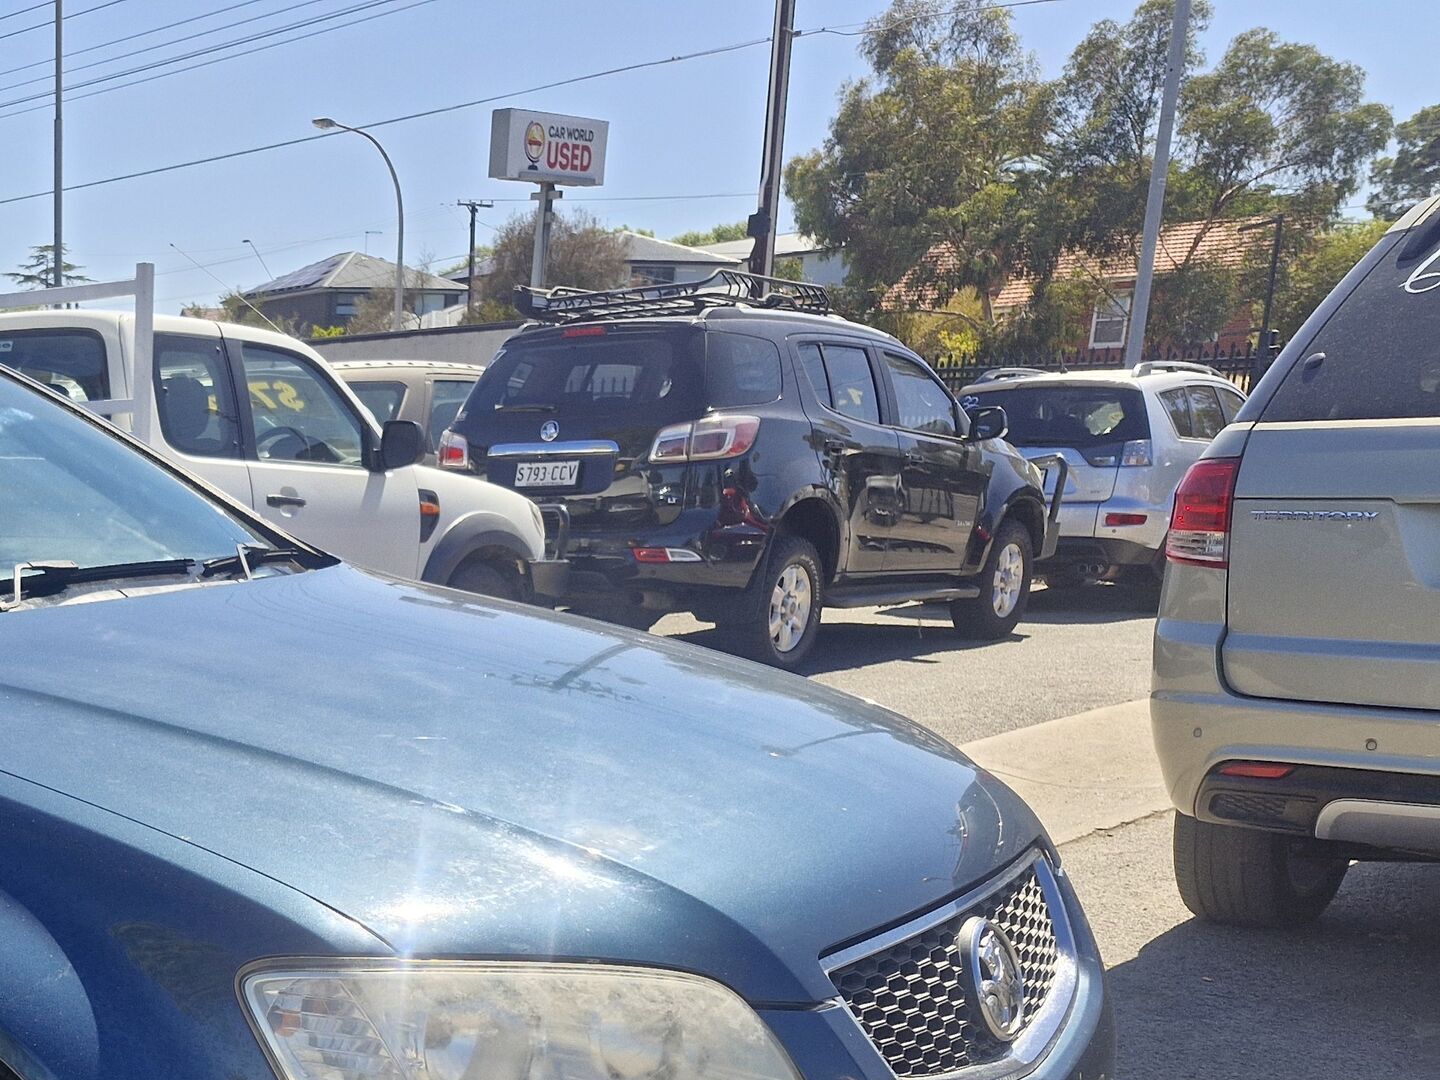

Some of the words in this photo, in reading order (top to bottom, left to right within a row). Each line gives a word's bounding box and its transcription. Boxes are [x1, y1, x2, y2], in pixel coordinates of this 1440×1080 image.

[548, 125, 566, 139] CAR
[567, 127, 595, 143] WORLD
[546, 141, 593, 172] USED
[1250, 510, 1380, 522] TERRITORY
